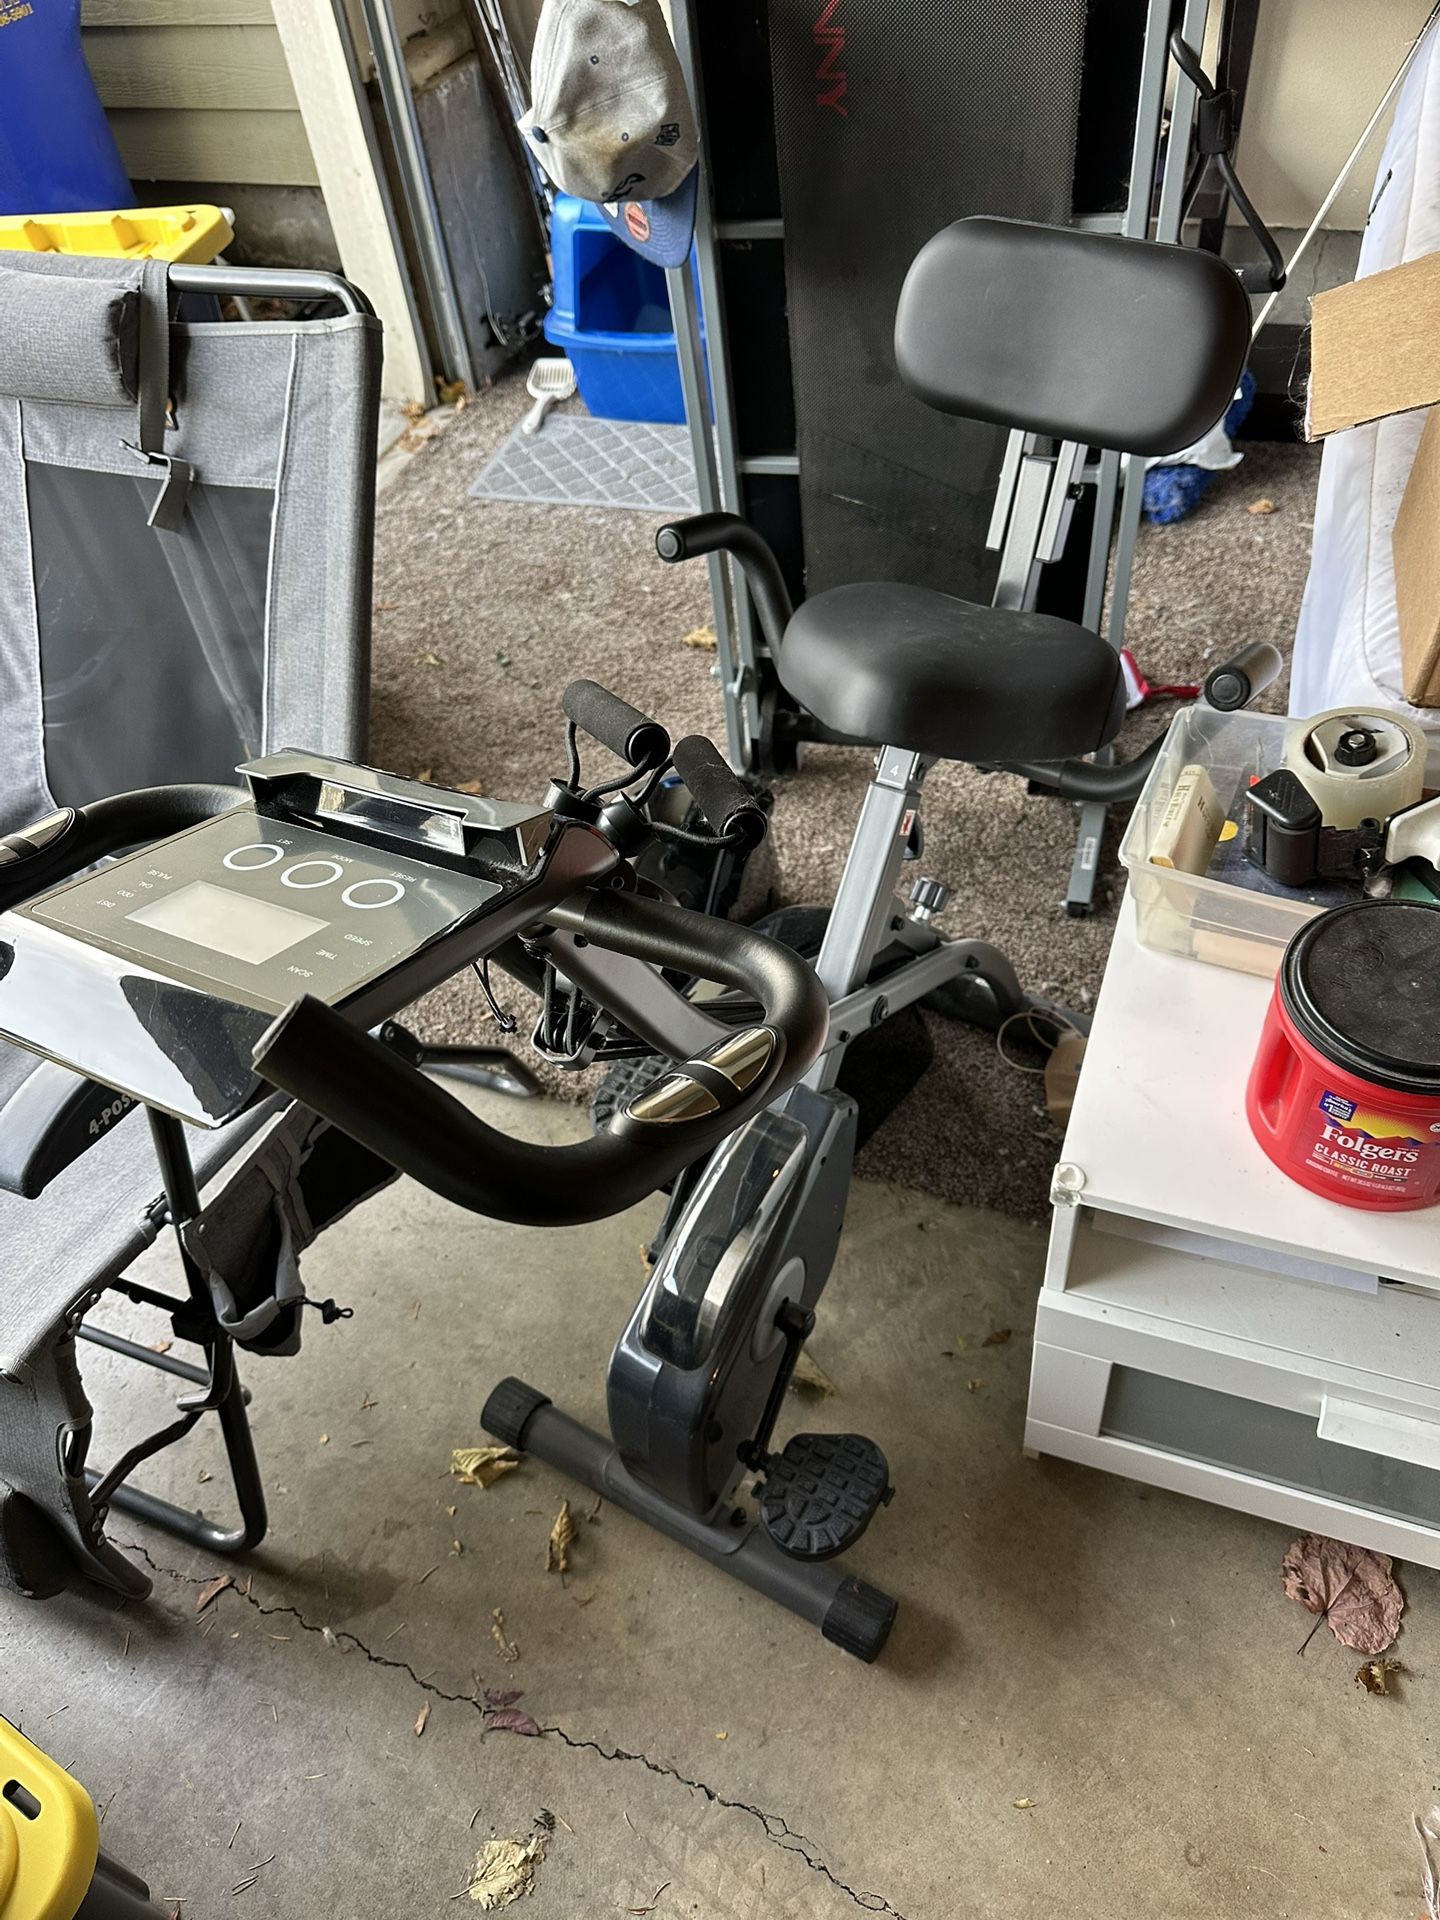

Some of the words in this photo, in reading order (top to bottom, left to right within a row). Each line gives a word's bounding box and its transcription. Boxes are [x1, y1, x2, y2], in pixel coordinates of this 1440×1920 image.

[889, 764, 899, 777] 4
[276, 837, 293, 846] SET
[330, 853, 354, 864] MODE
[146, 868, 173, 881] PULSE
[388, 870, 417, 883] RESET
[117, 888, 135, 899] ODO
[96, 898, 116, 909] DIST
[343, 933, 373, 946] SPEED
[315, 948, 338, 961] TIME
[286, 964, 314, 978] SCAN
[89, 1093, 134, 1135] 4-POS
[1320, 1123, 1419, 1163] Folgers
[1314, 1142, 1369, 1170] CLASSIC
[1371, 1162, 1412, 1177] ROAST
